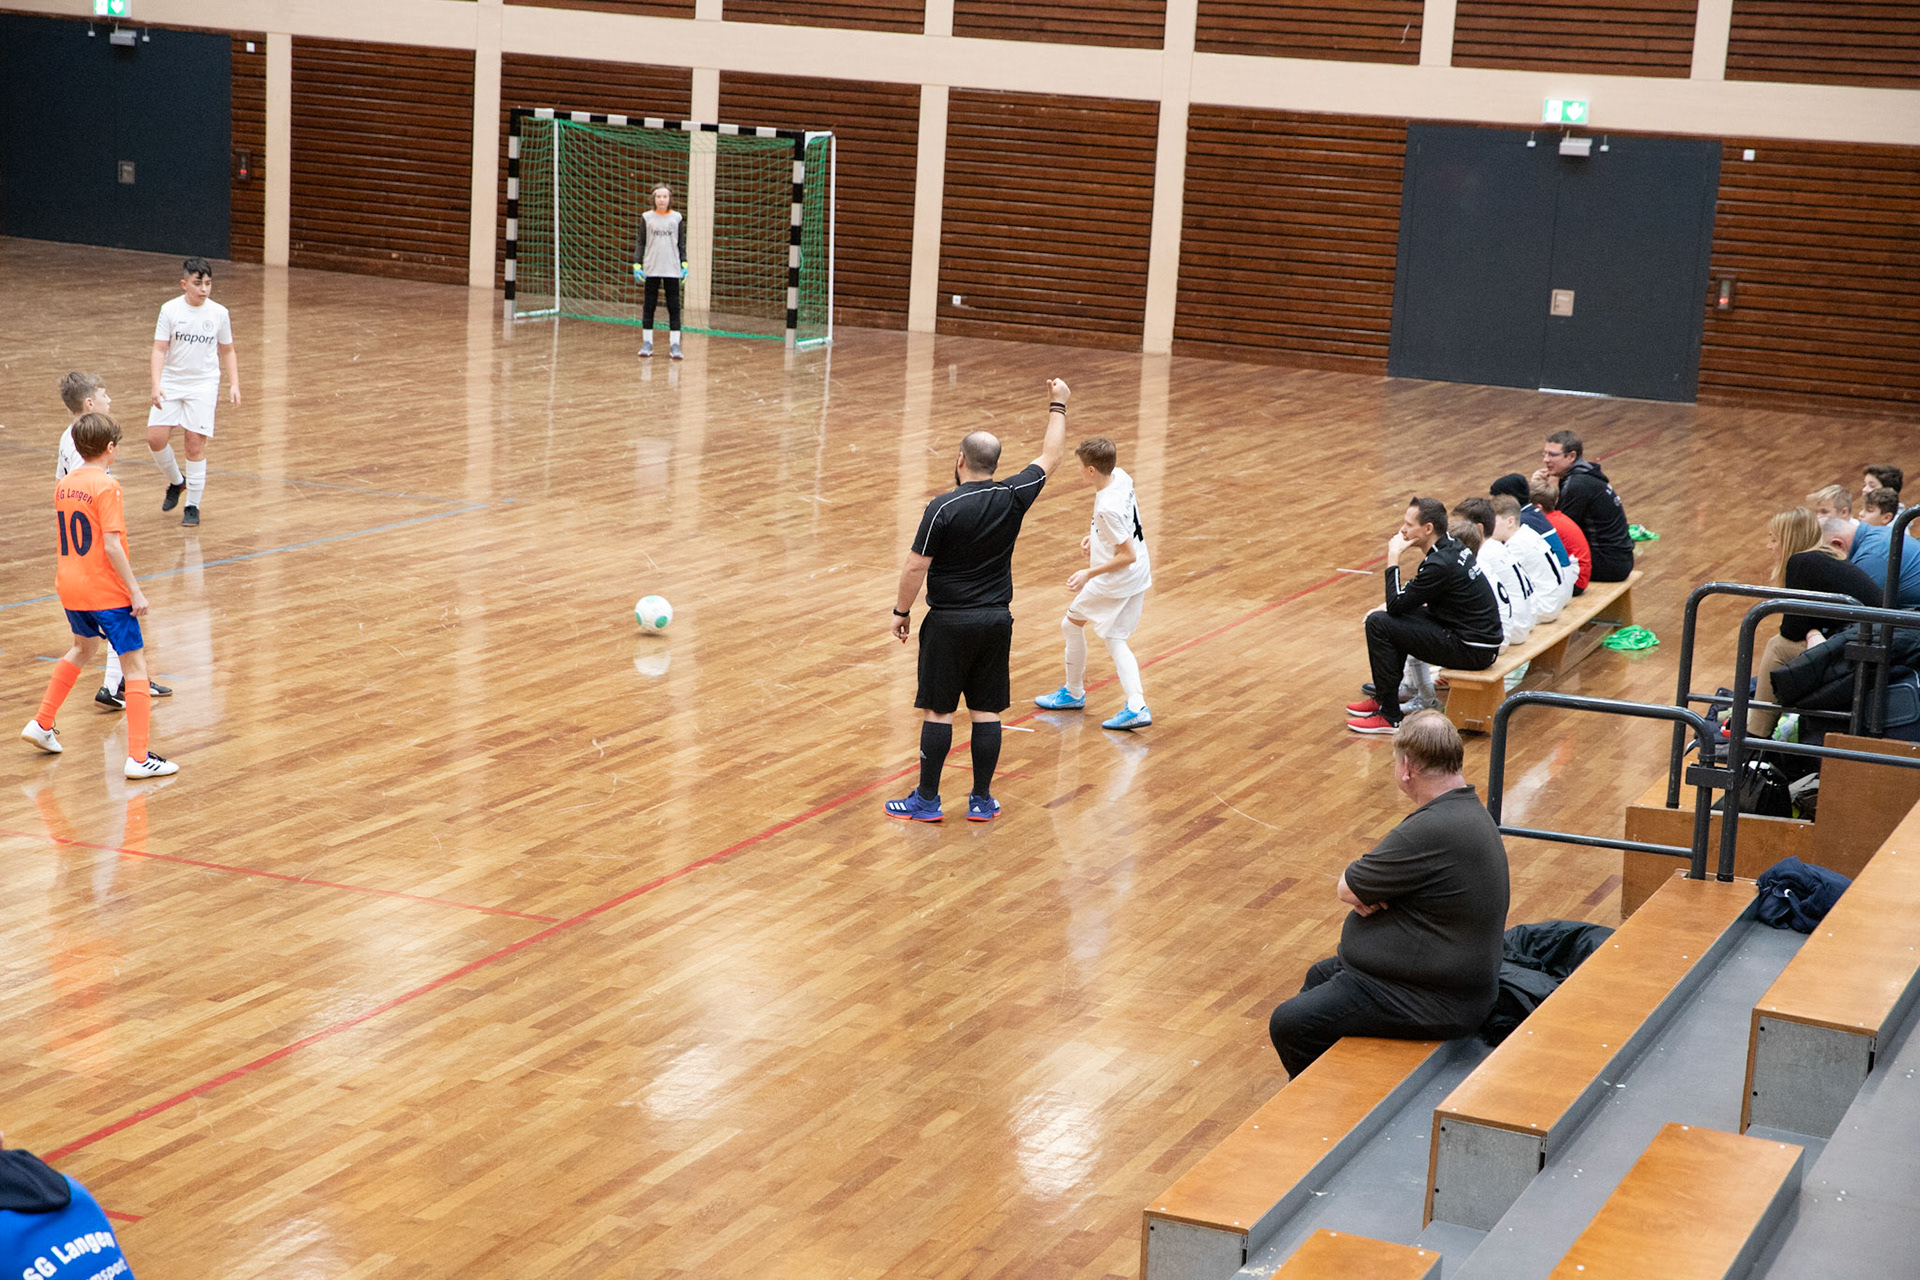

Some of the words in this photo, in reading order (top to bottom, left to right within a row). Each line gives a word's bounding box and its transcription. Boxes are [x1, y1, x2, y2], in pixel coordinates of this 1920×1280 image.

[175, 331, 214, 345] Fraport
[67, 488, 93, 504] Langen
[57, 510, 92, 557] 10
[22, 1256, 58, 1280] SG
[51, 1231, 116, 1265] Langen
